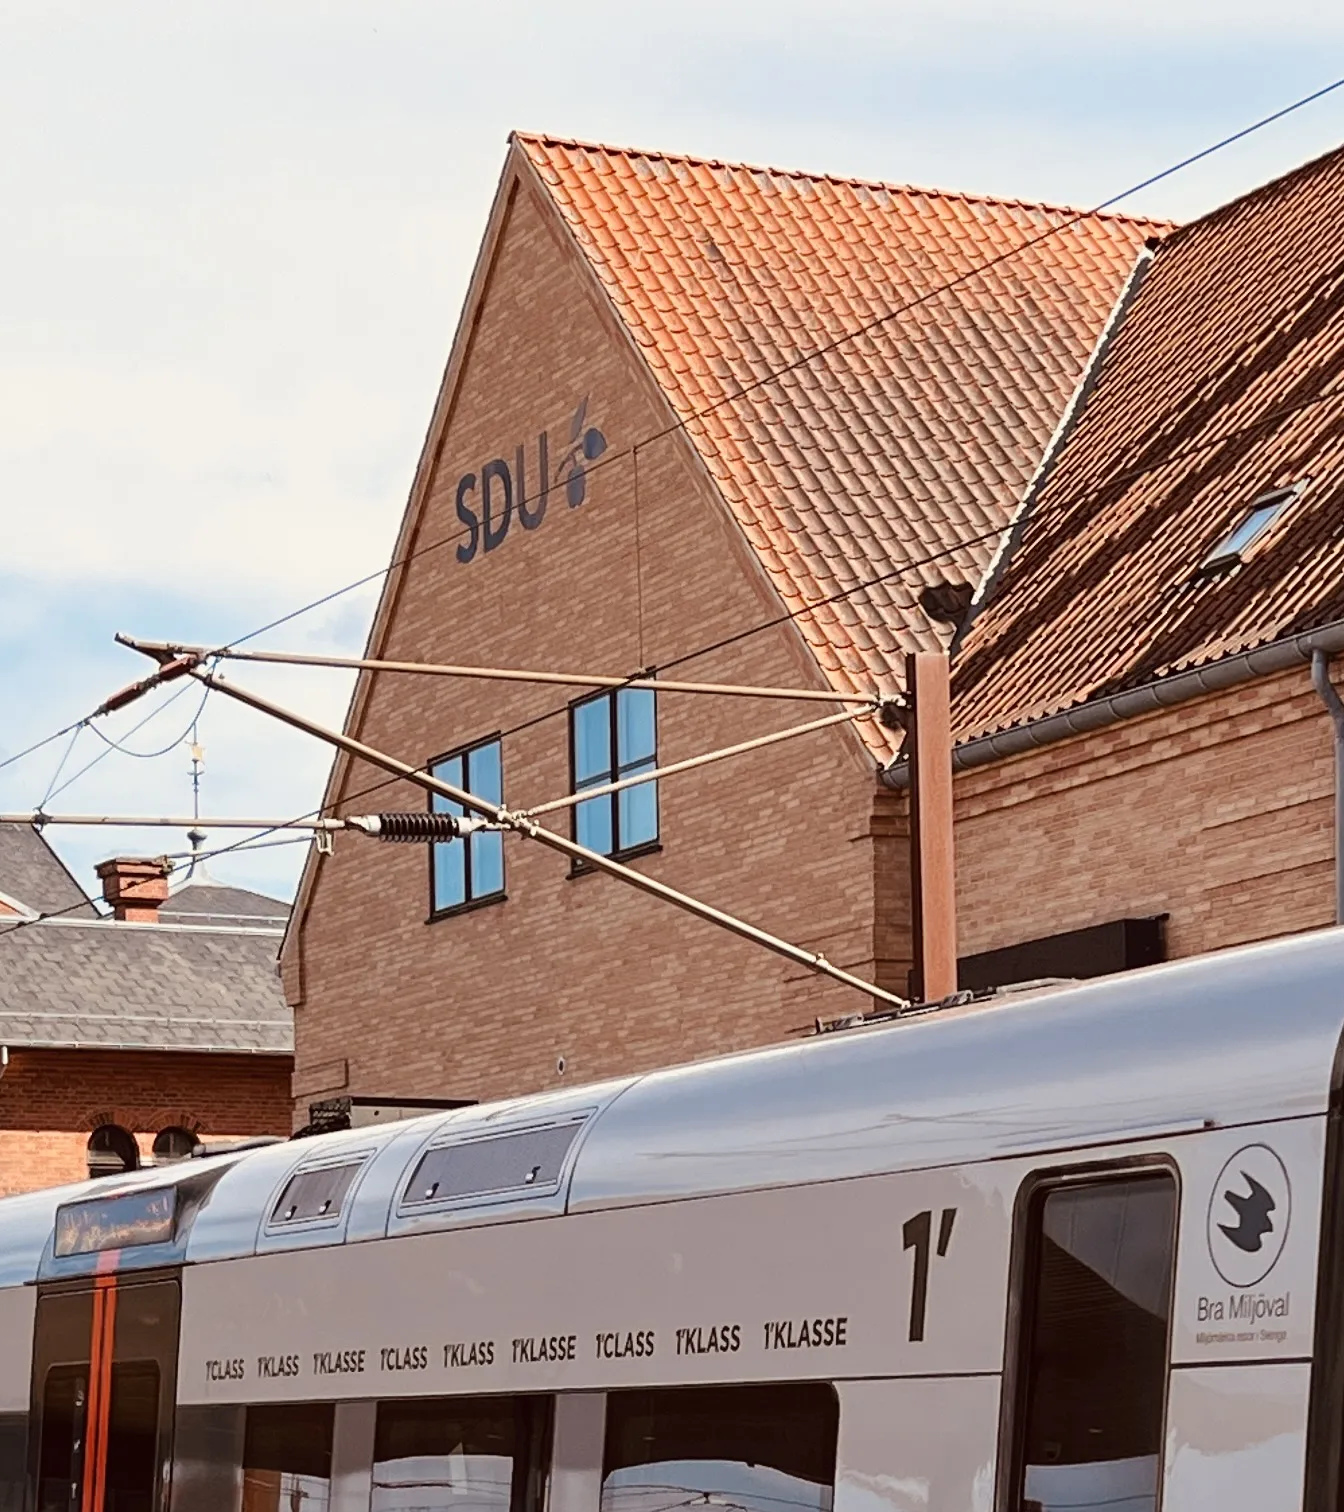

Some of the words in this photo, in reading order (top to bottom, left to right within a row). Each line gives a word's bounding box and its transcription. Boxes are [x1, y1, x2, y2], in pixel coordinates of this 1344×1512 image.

[455, 430, 549, 565] SDU
[1197, 1296, 1224, 1322] Bra
[1229, 1291, 1290, 1325] Miljöval
